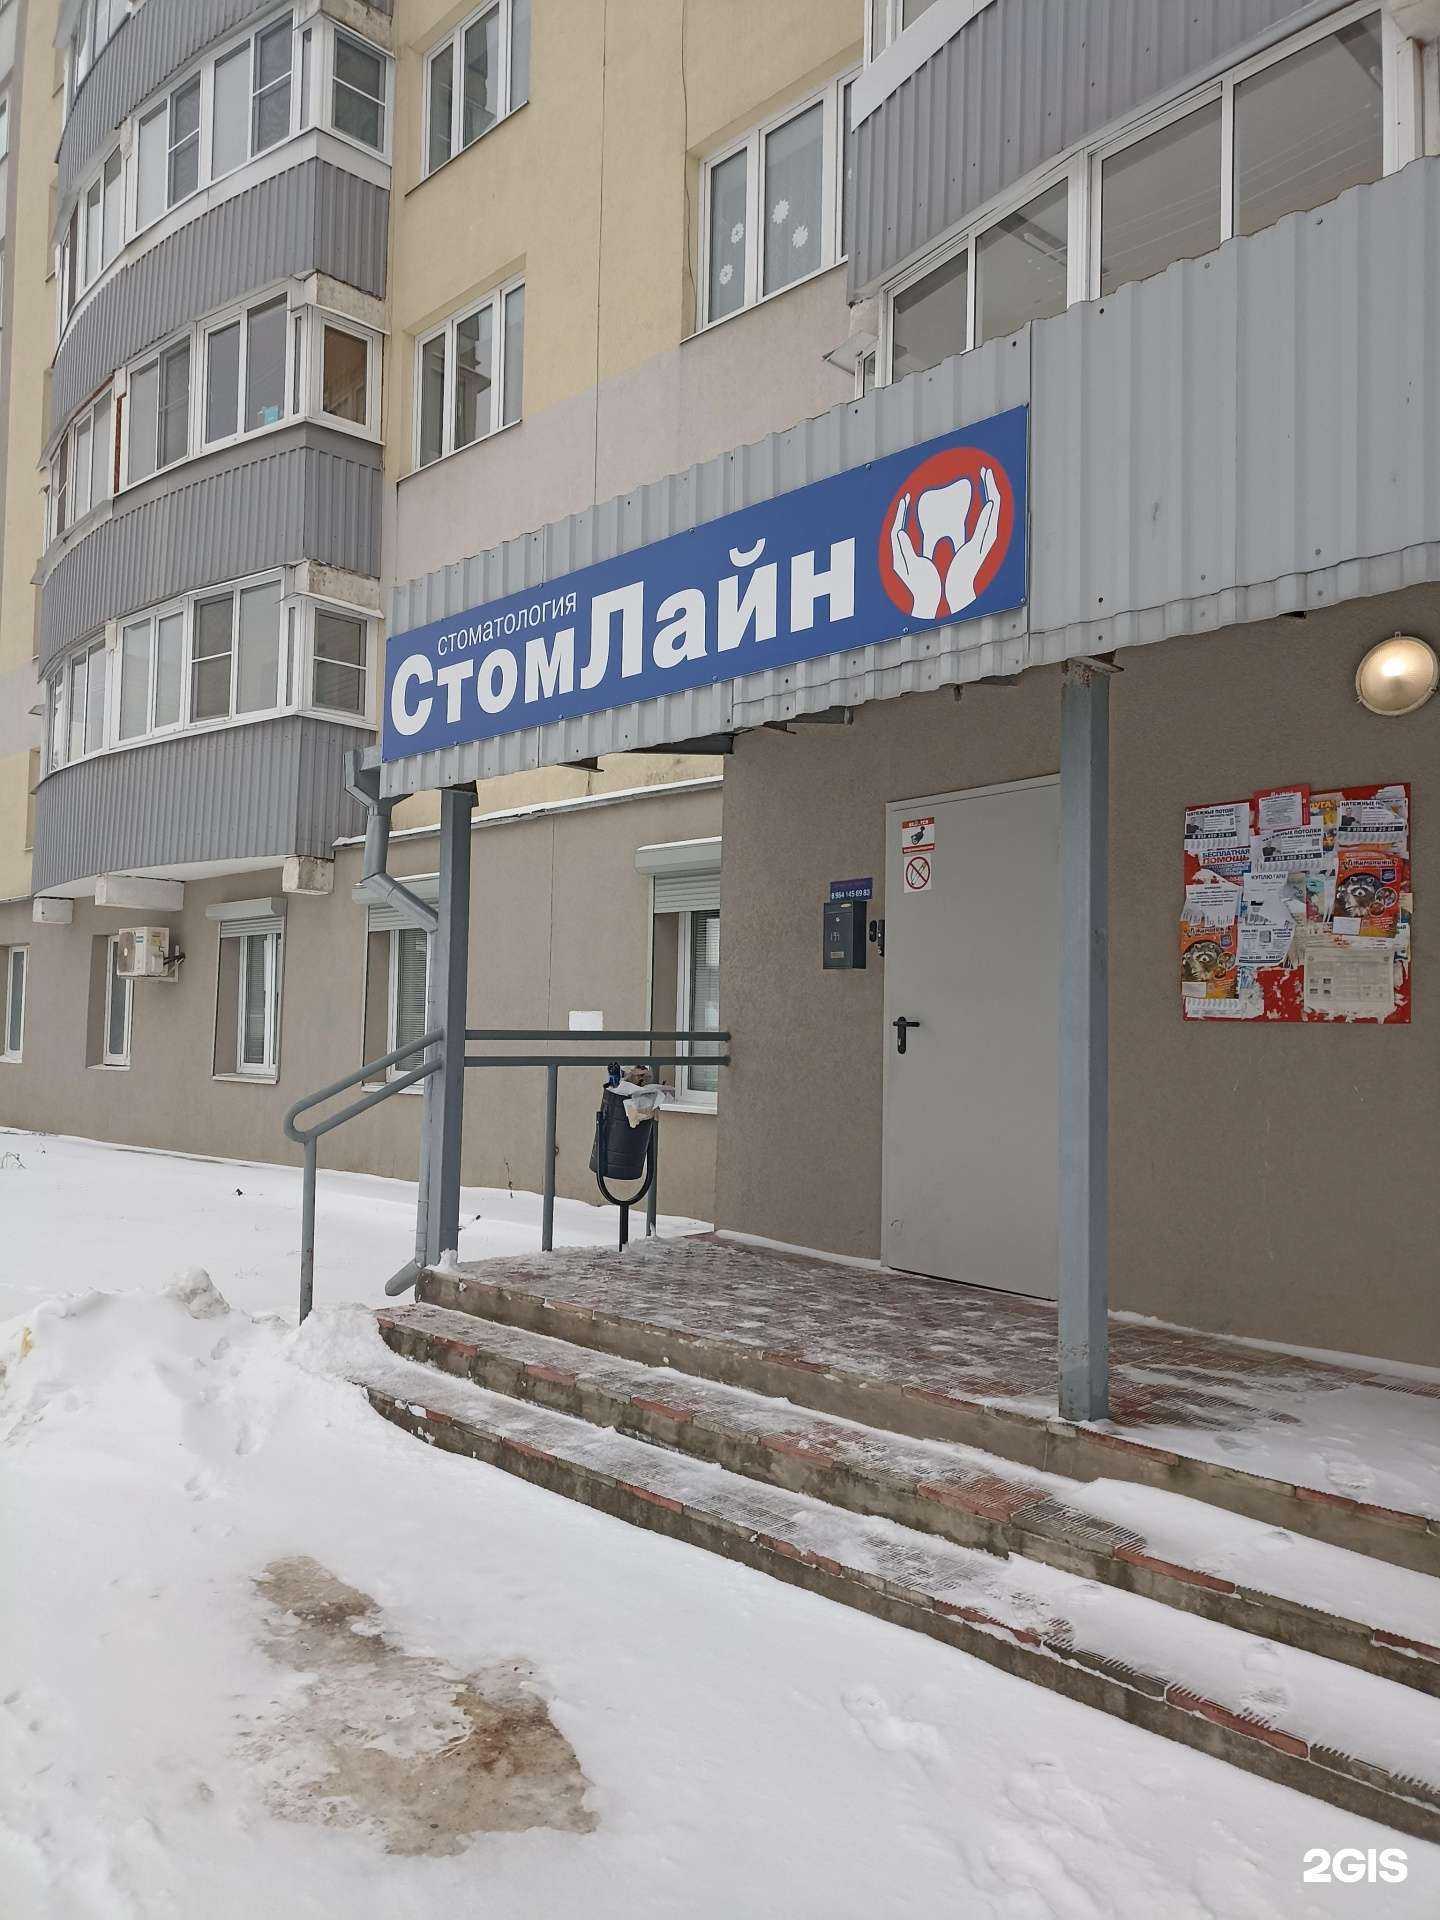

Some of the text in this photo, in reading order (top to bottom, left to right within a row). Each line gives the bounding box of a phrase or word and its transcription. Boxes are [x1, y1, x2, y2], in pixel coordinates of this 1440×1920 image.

[390, 537, 856, 737] СтомЛайн
[1202, 849, 1250, 858] БЕСПЛАТНАЯ
[1202, 855, 1250, 864] ПОМОЩЬ
